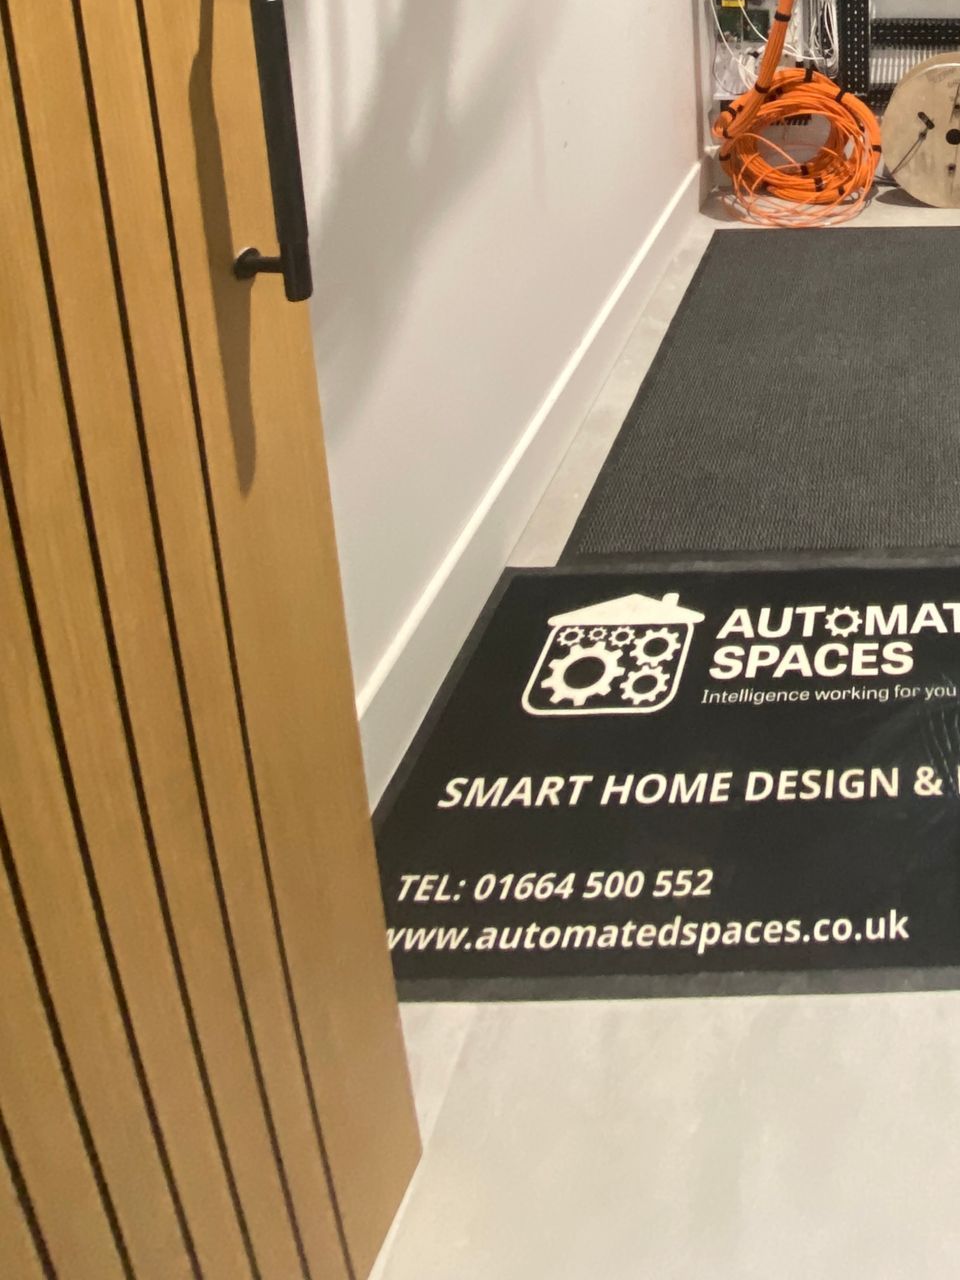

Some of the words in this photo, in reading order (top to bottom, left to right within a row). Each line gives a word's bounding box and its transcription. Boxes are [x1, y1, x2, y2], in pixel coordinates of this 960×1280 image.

[708, 640, 914, 680] SPACES
[701, 687, 811, 706] Intelligence
[814, 686, 890, 702] working
[893, 683, 918, 699] for
[923, 685, 958, 702] you
[437, 774, 594, 808] SMART
[600, 771, 734, 806] HOME
[744, 766, 899, 802] DESIGN
[913, 765, 944, 797] &
[397, 874, 466, 902] TEL:
[473, 872, 576, 901] 01664
[582, 870, 645, 899] 500
[652, 868, 714, 898] 552
